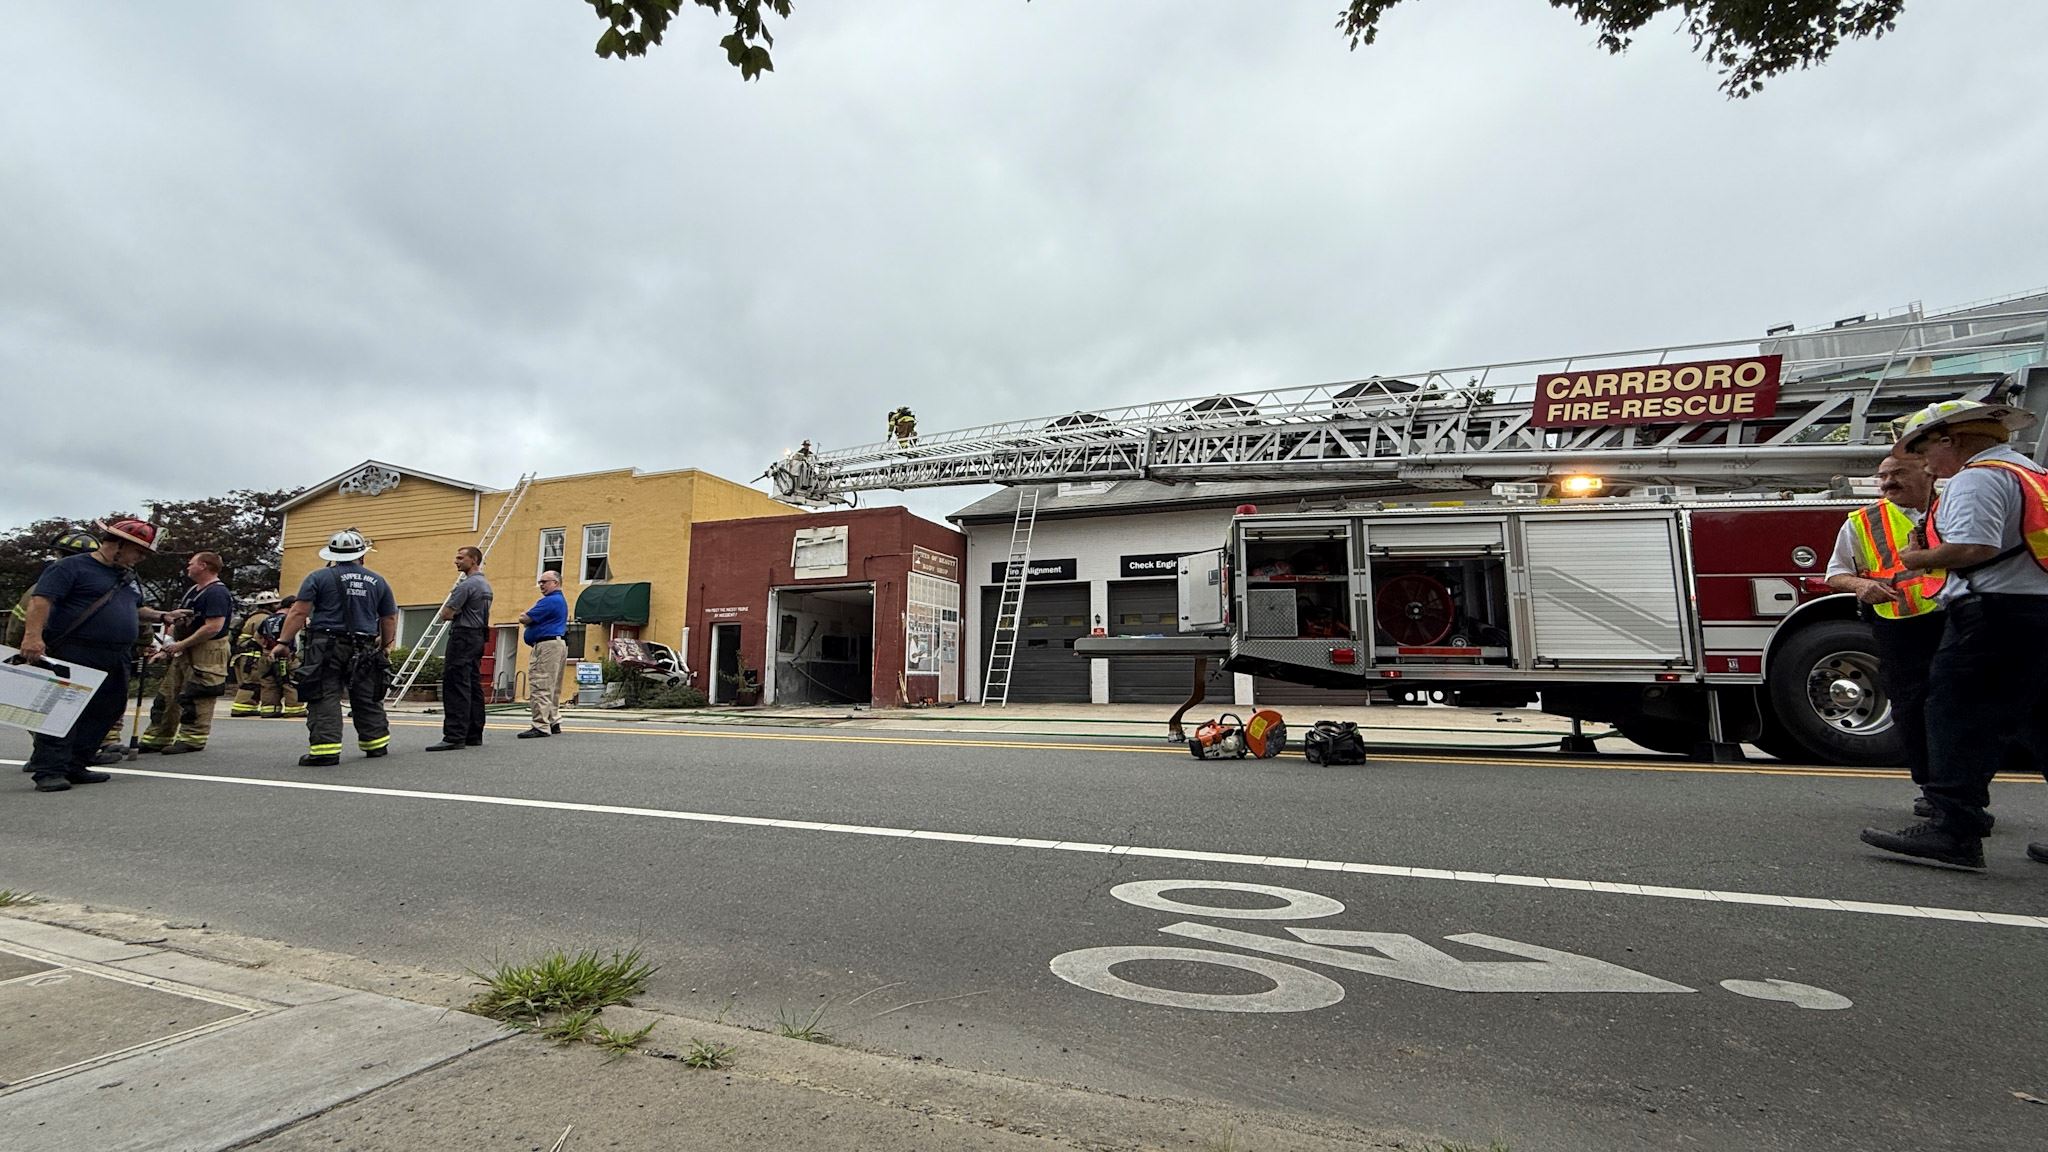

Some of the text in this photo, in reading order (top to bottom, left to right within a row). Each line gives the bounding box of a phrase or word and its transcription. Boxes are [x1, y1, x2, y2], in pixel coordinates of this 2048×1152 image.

[1546, 361, 1766, 400] CARRBORO
[1547, 392, 1756, 422] FIRE-RESCUE
[1129, 561, 1154, 569] Check
[363, 575, 378, 586] HILL
